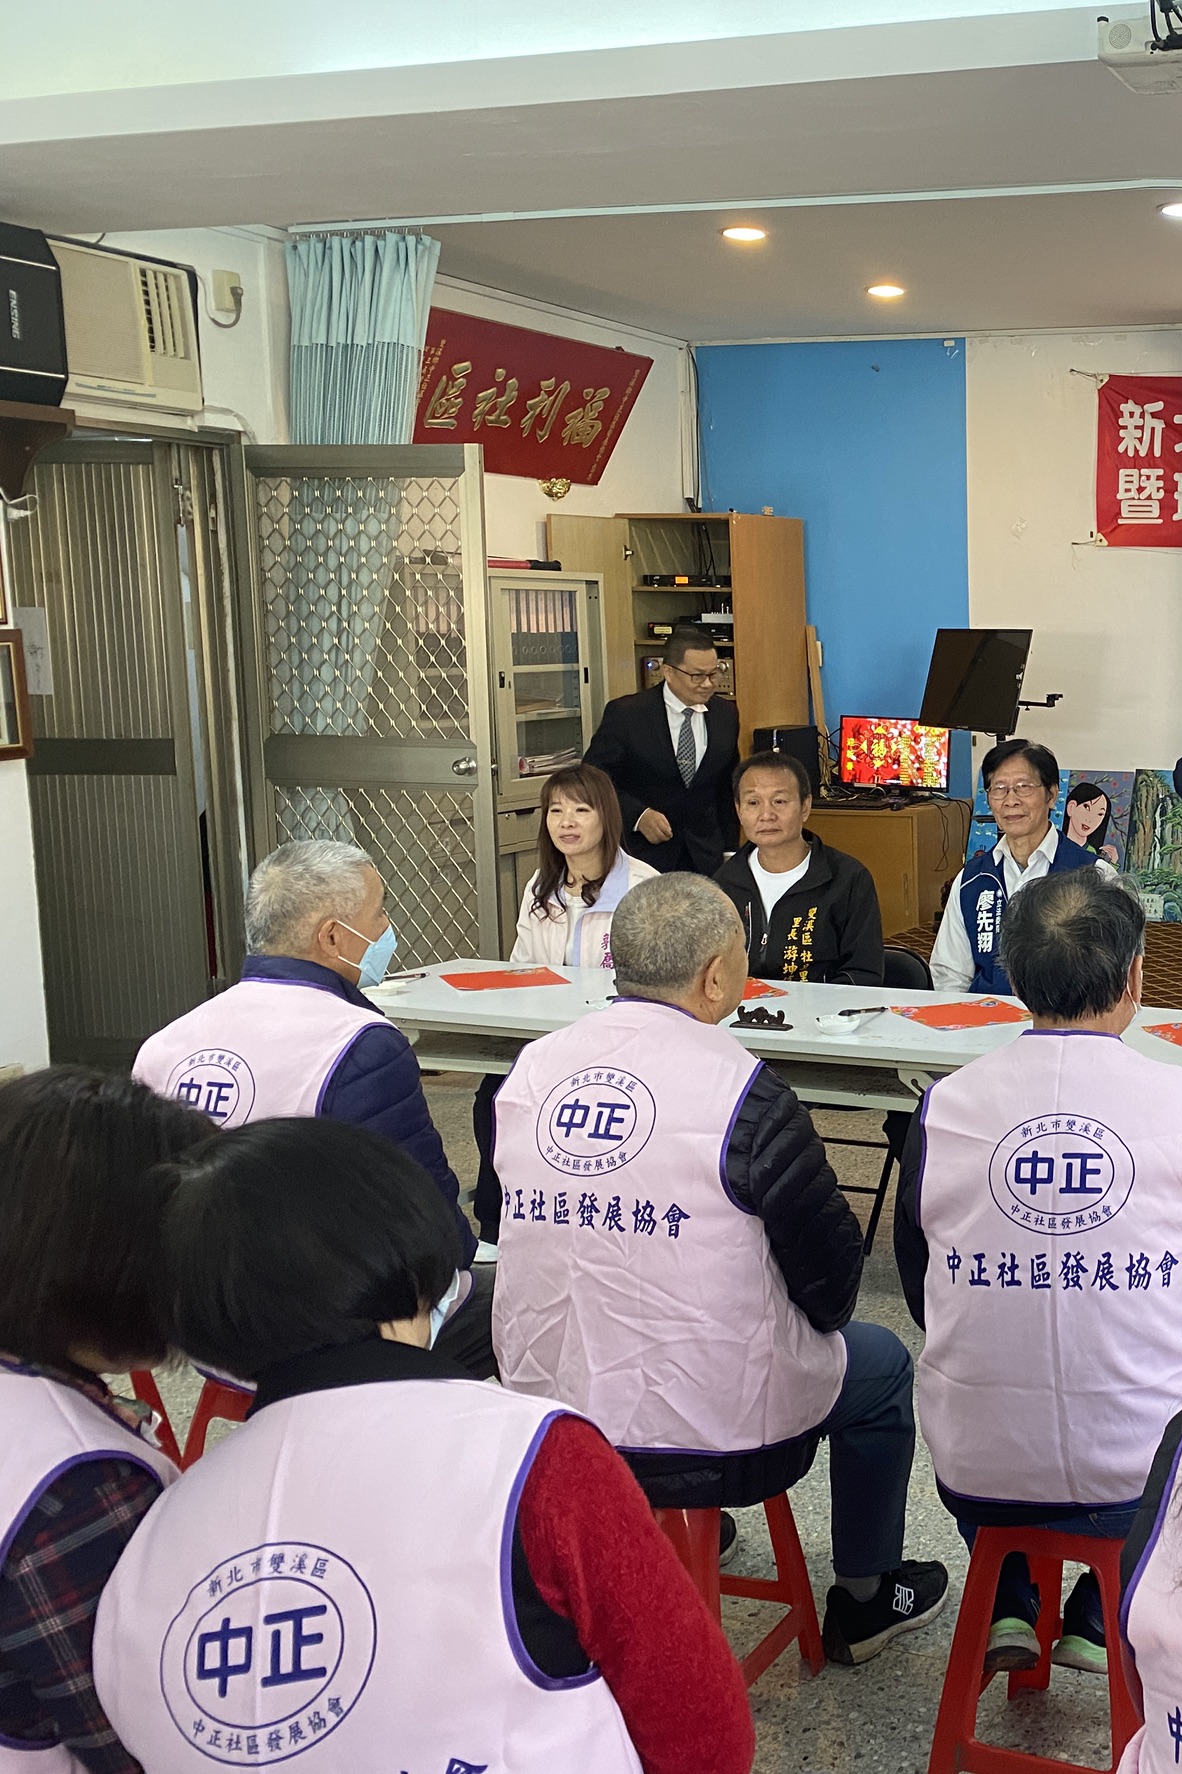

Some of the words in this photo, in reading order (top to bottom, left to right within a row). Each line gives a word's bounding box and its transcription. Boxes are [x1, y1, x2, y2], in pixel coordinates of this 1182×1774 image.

[976, 889, 995, 953] 廖先翔
[177, 1077, 234, 1118] 中正
[569, 1070, 639, 1093] 新北市雙溪區
[555, 1098, 631, 1142] 中正
[1020, 1118, 1106, 1141] 新北市雙溪區
[545, 1145, 628, 1172] 中正社區發展協會
[1014, 1150, 1104, 1196] 中正
[503, 1185, 691, 1239] 中正社區發展協會
[1010, 1204, 1114, 1230] 中正社區發展協會
[946, 1247, 1180, 1292] 中正社區發展協會
[206, 1552, 330, 1598] 新北市雙溪區
[196, 1604, 328, 1699] 中正
[191, 1696, 346, 1756] 中正社區發展協會
